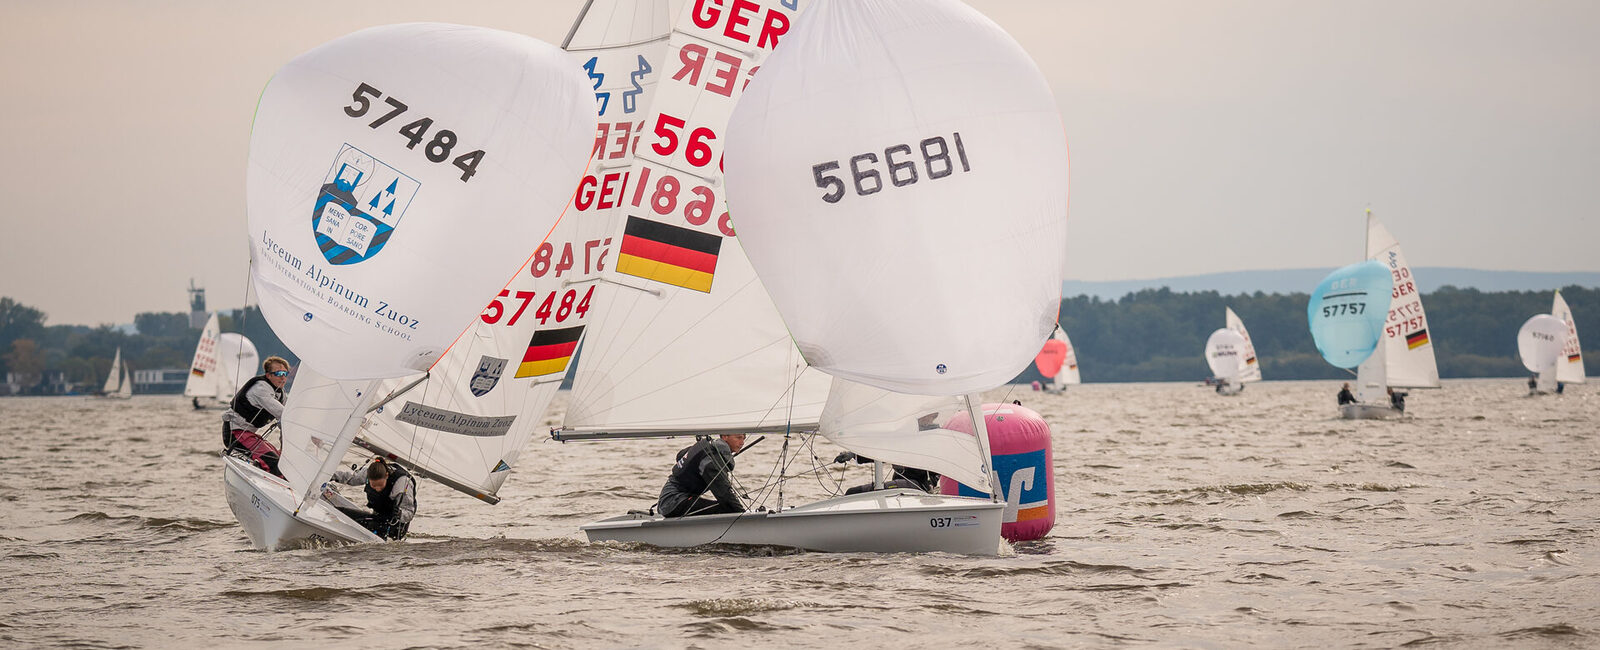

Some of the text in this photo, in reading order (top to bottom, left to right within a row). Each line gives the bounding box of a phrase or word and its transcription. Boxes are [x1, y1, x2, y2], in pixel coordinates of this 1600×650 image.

[692, 0, 790, 51] GER
[344, 82, 486, 183] 57484
[651, 113, 724, 174] 56
[812, 132, 971, 204] 56681
[575, 172, 630, 211] GE
[326, 216, 340, 228] SANA
[328, 207, 345, 220] MENS
[350, 229, 366, 241] PORE
[355, 222, 369, 232] COR-
[346, 238, 363, 250] SANO
[262, 230, 420, 330] Lyceum Alpinum Zuoz
[480, 285, 596, 326] 57484
[1323, 302, 1366, 318] 57757
[327, 296, 371, 324] BOARDING
[375, 321, 412, 342] SCHOOL
[1386, 316, 1423, 338] 57757
[403, 404, 446, 422] Lyceum
[449, 414, 490, 429] Alpinum
[491, 419, 514, 428] Zuoz
[930, 517, 952, 528] 037
